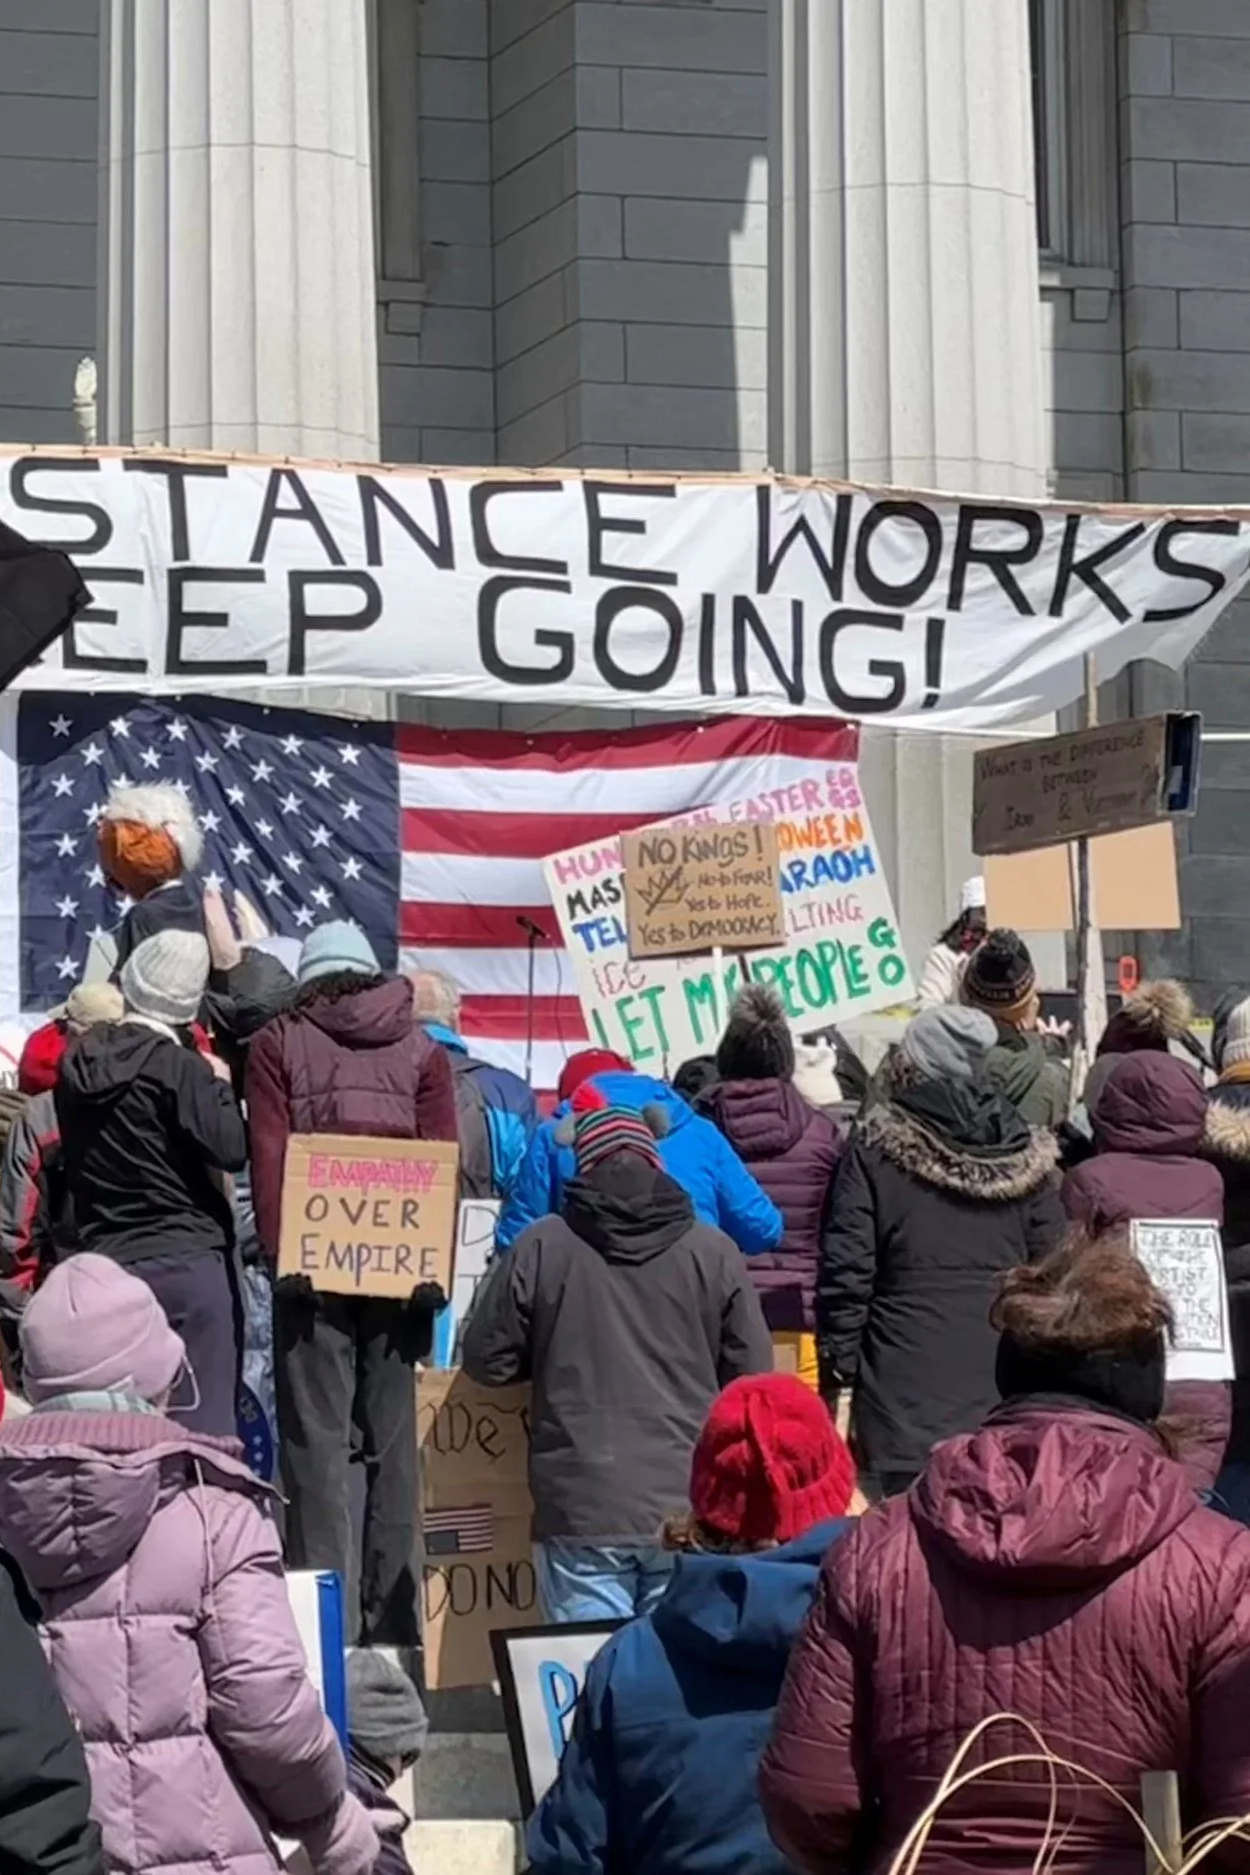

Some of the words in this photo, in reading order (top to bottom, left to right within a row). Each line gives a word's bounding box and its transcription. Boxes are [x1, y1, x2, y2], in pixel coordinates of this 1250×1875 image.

[756, 484, 1240, 625] WORKS
[477, 575, 946, 713] GOING!
[553, 840, 625, 885] HUN
[637, 836, 677, 868] NO
[304, 1194, 420, 1229] OVER
[301, 1233, 439, 1287] EMPIRE
